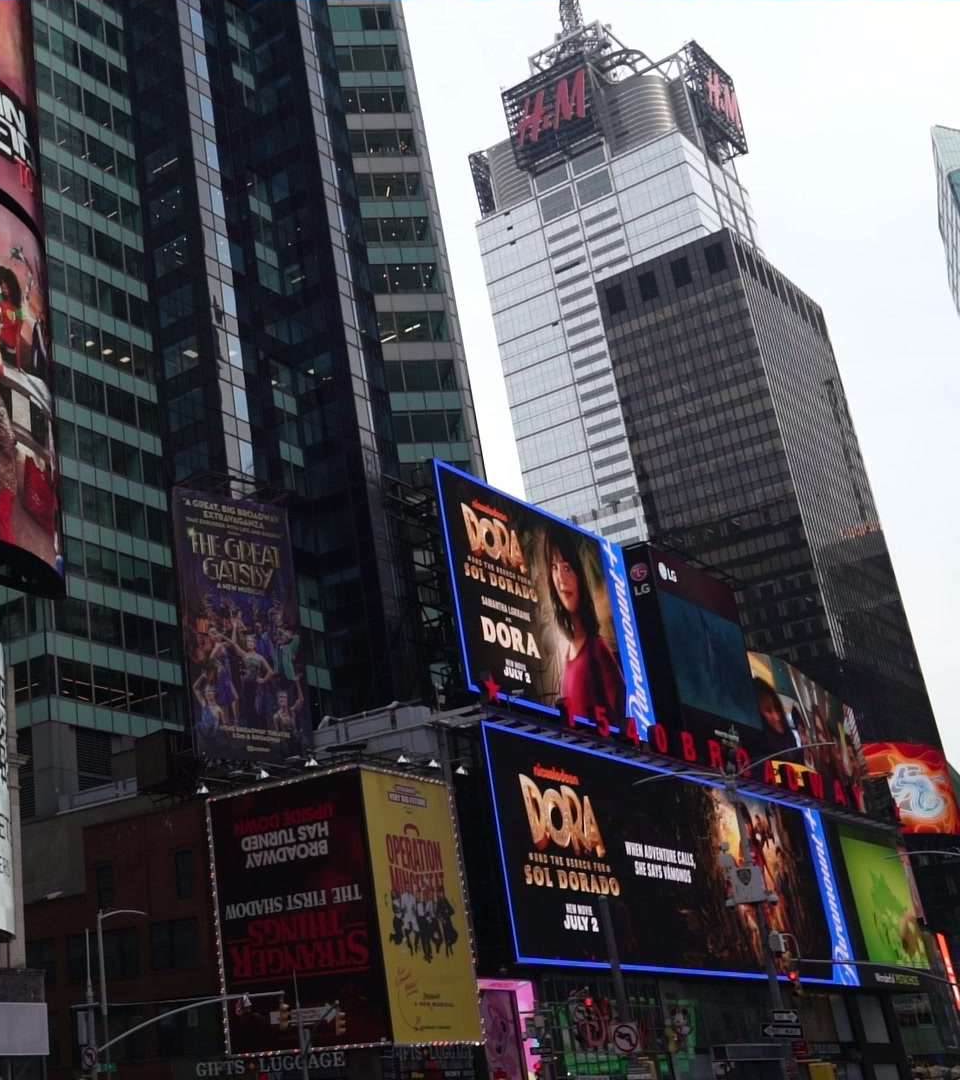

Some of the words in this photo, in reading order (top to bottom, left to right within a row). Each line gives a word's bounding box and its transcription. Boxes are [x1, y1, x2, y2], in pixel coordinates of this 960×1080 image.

[191, 531, 222, 558] THE
[224, 537, 281, 569] GREAT
[460, 502, 527, 574] DORA
[202, 556, 275, 590] GATSBY
[464, 561, 486, 583] SOL
[489, 570, 539, 603] DORADO
[666, 567, 678, 583] LG
[633, 583, 651, 596] LG
[480, 615, 541, 660] DORA
[503, 665, 524, 681] JULY
[525, 672, 532, 684] 2
[283, 801, 336, 829] UPSIDE
[518, 773, 606, 859] DORA
[240, 825, 297, 852] TURNED
[299, 820, 331, 840] HAS
[244, 839, 330, 869] BROADWAY
[386, 833, 444, 872] OPERATION
[624, 840, 644, 858] WHEN
[644, 844, 677, 864] ADVENTURE
[677, 850, 697, 870] CALLS,
[524, 864, 554, 888] SOL
[556, 869, 620, 897] DORADO
[634, 860, 647, 876] SHE
[647, 862, 663, 879] SAYS
[224, 894, 283, 921] SHADOW
[286, 887, 327, 911] FIRST
[332, 883, 363, 904] THE
[247, 908, 345, 942] THINGS
[563, 914, 588, 931] JULY
[590, 917, 599, 933] 2
[229, 926, 371, 980] STRANGER
[195, 1059, 246, 1077] GIFTS
